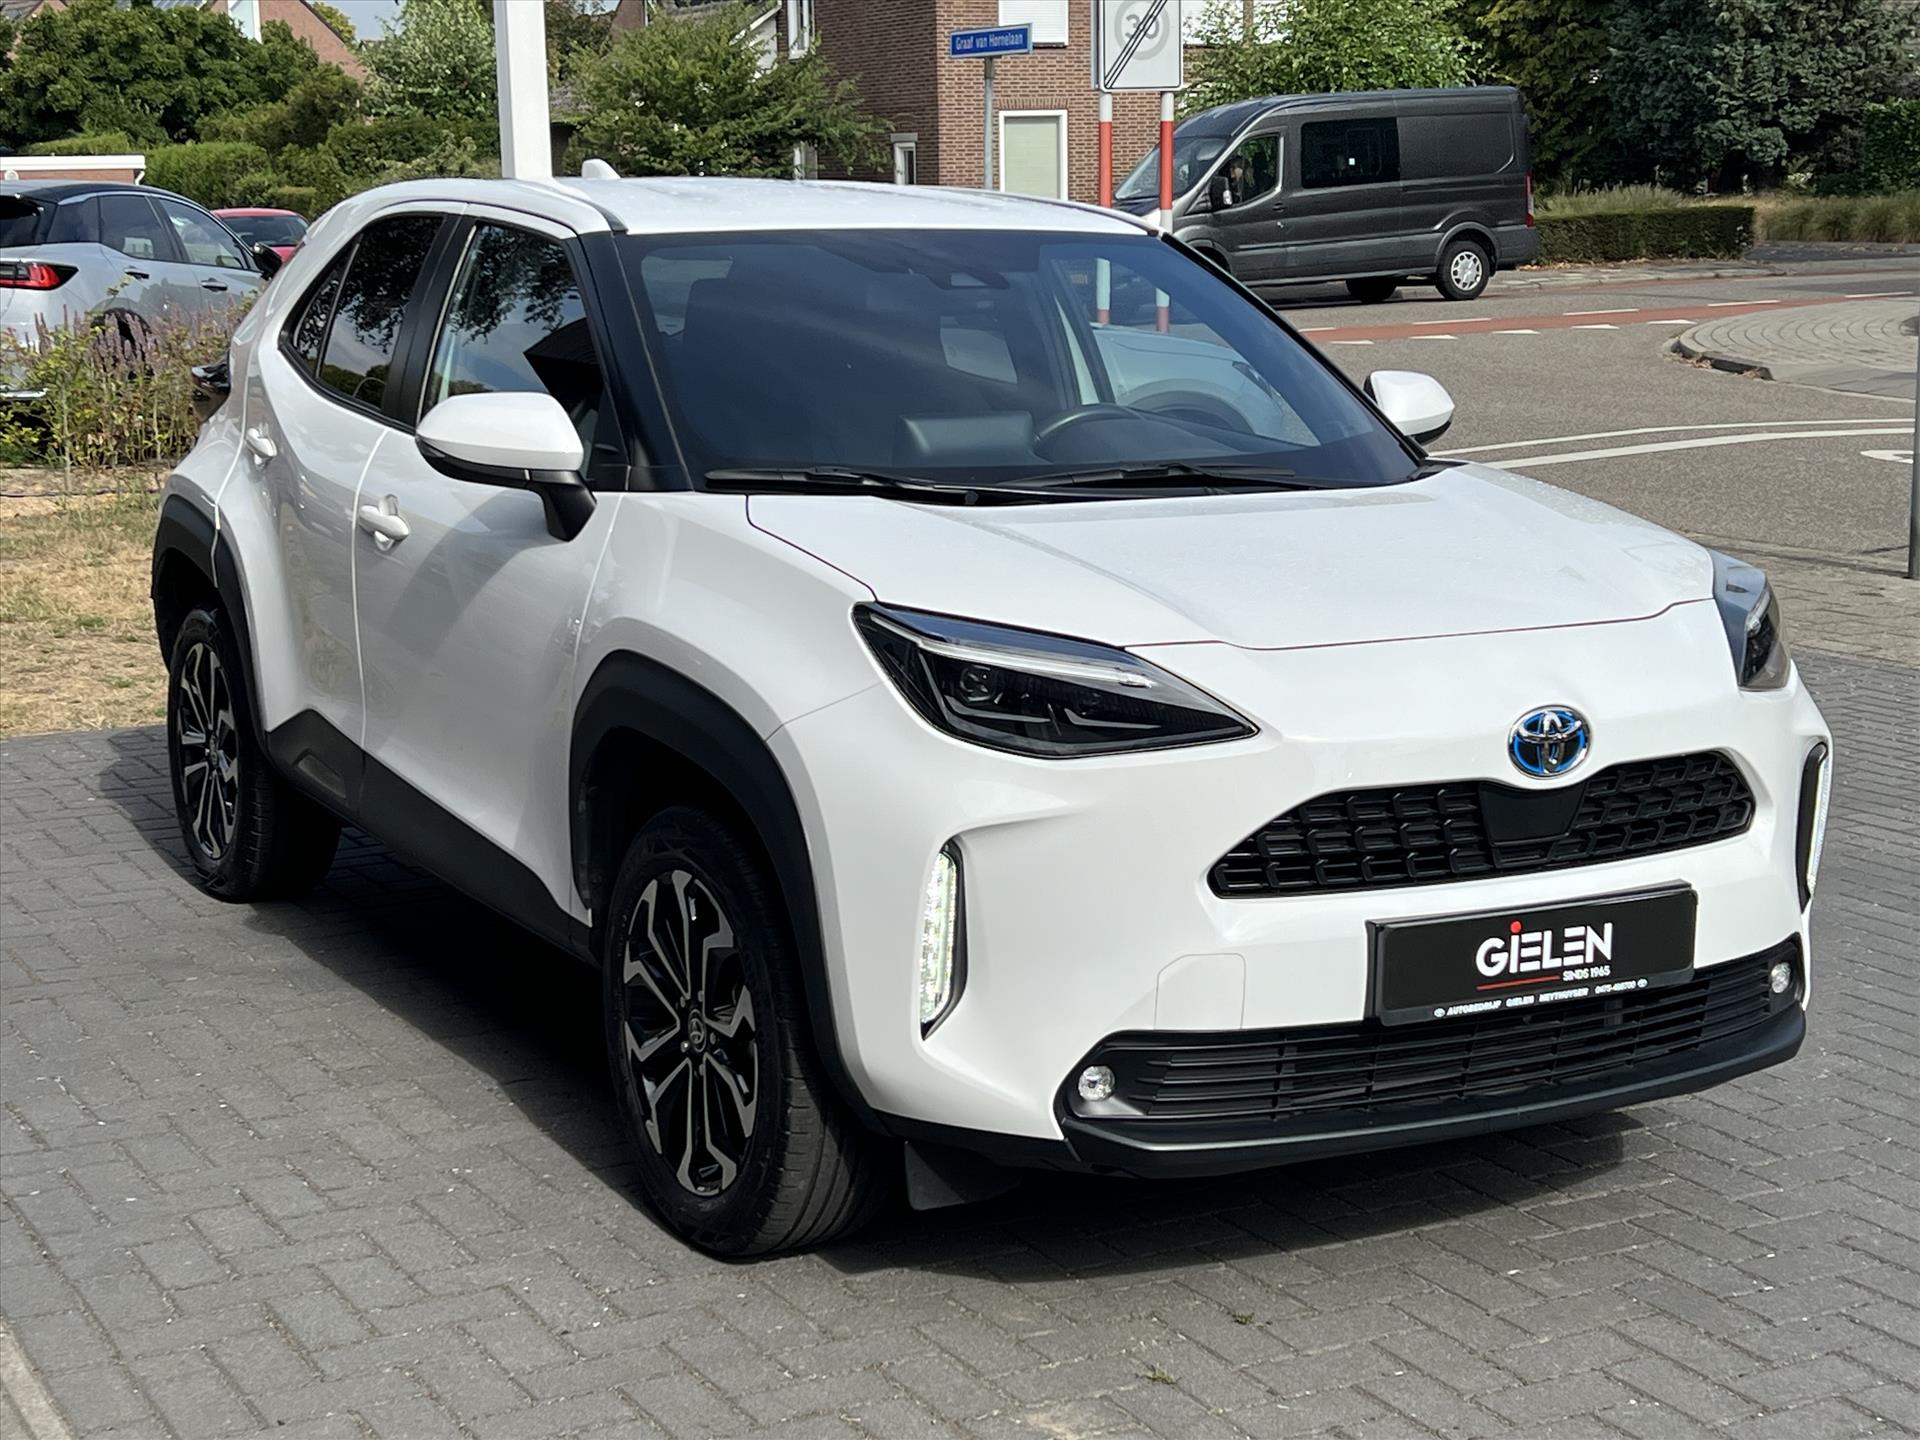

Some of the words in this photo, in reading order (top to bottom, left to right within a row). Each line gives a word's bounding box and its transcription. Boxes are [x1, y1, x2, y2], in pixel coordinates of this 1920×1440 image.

[1124, 14, 1160, 40] 30
[956, 35, 974, 50] Graaf
[975, 36, 988, 49] van
[989, 32, 1024, 47] Hornelaan
[1562, 967, 1589, 981] SINDS
[1590, 965, 1611, 978] 1965
[1446, 1000, 1502, 1016] AUTOBEDRIJF
[1505, 995, 1535, 1007] GIELEN
